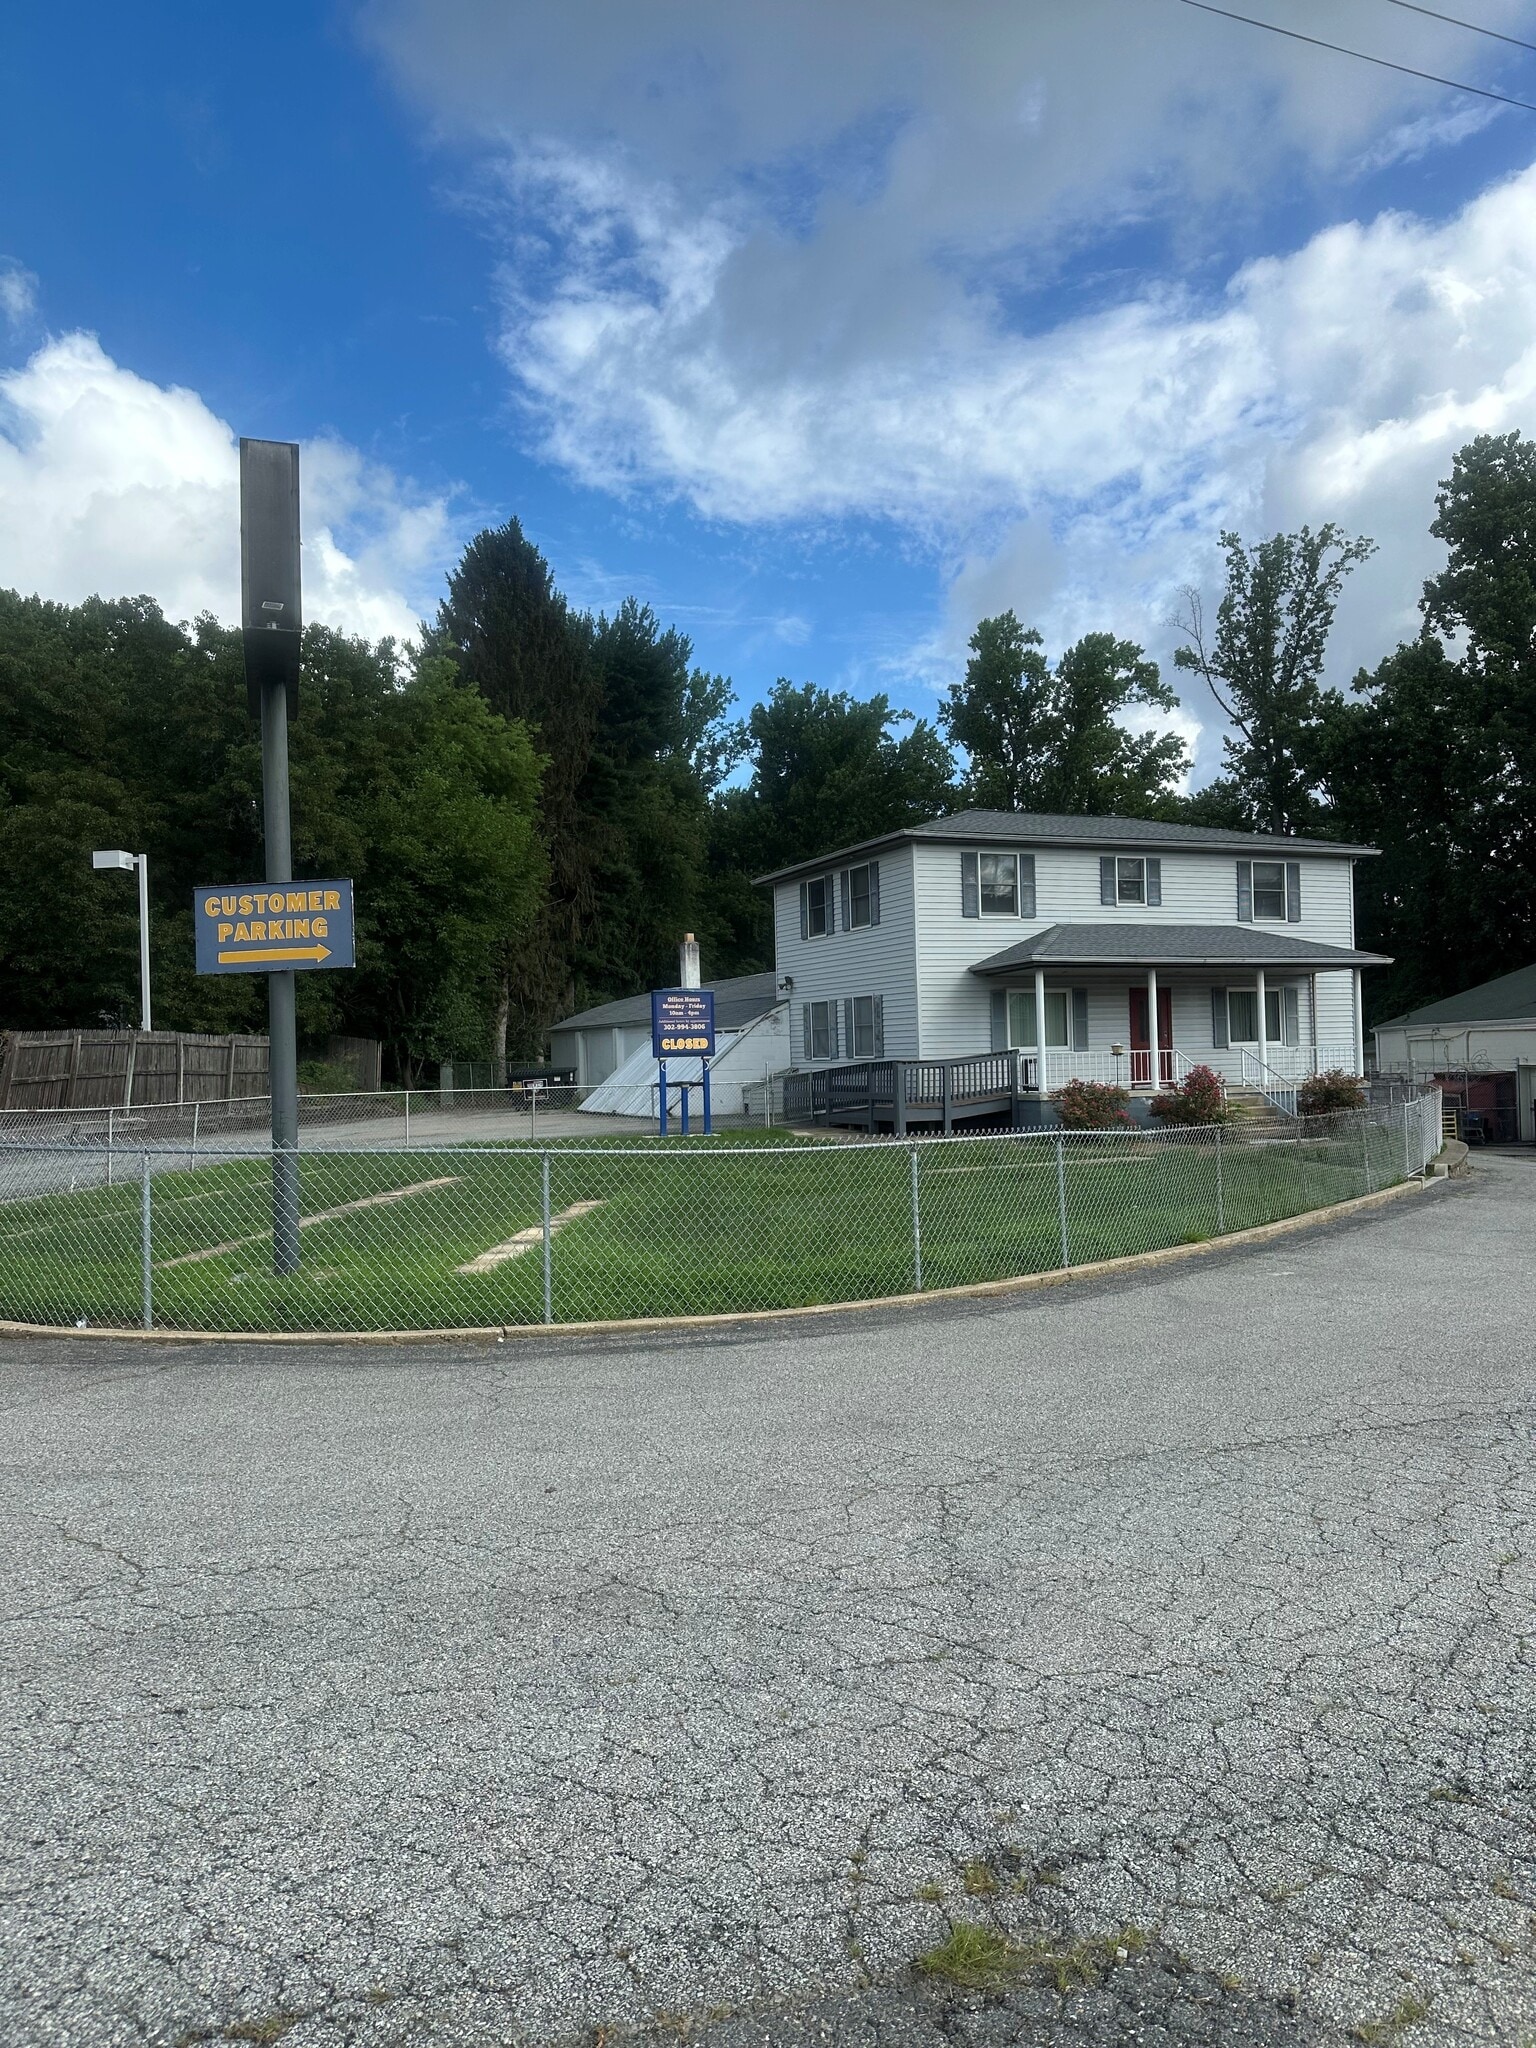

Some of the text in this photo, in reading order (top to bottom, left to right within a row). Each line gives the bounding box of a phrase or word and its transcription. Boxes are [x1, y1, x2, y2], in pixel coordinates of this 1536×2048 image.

[204, 890, 341, 917] CUSTOMER
[218, 917, 329, 943] PARKING
[661, 1037, 709, 1050] CLOSED
